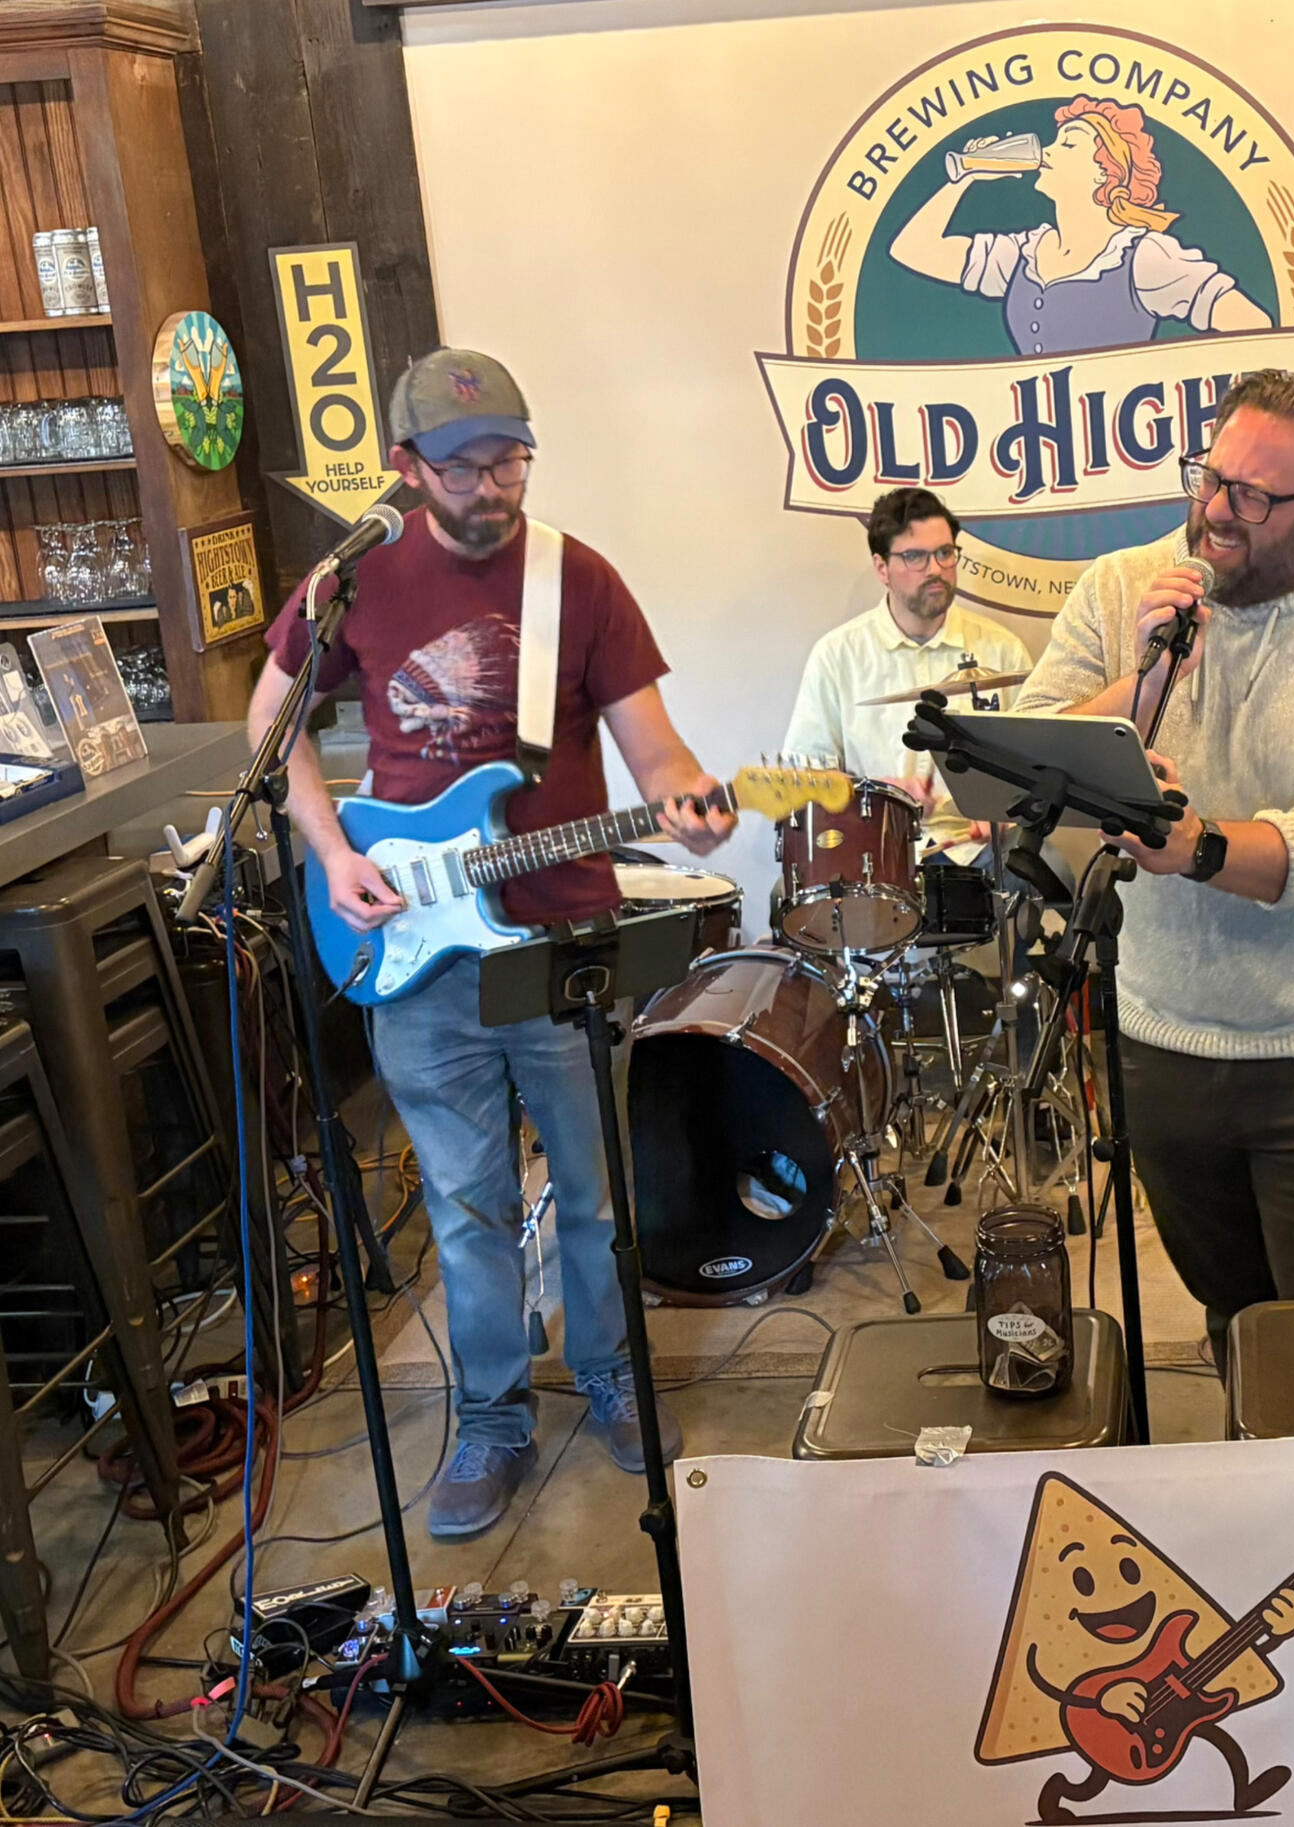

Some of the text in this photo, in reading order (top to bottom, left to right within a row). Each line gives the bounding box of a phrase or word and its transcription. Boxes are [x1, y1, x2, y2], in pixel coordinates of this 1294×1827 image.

[847, 50, 1271, 201] BREWING COMPANY
[801, 378, 979, 493] OLD
[325, 462, 365, 477] HELP
[305, 475, 386, 493] YOURSELF
[211, 566, 227, 589] BEER
[960, 554, 1080, 595] TSTOWN, NE
[704, 1259, 747, 1275] EVANS
[996, 1328, 1037, 1337] Musicians
[998, 1321, 1021, 1329] TIPS
